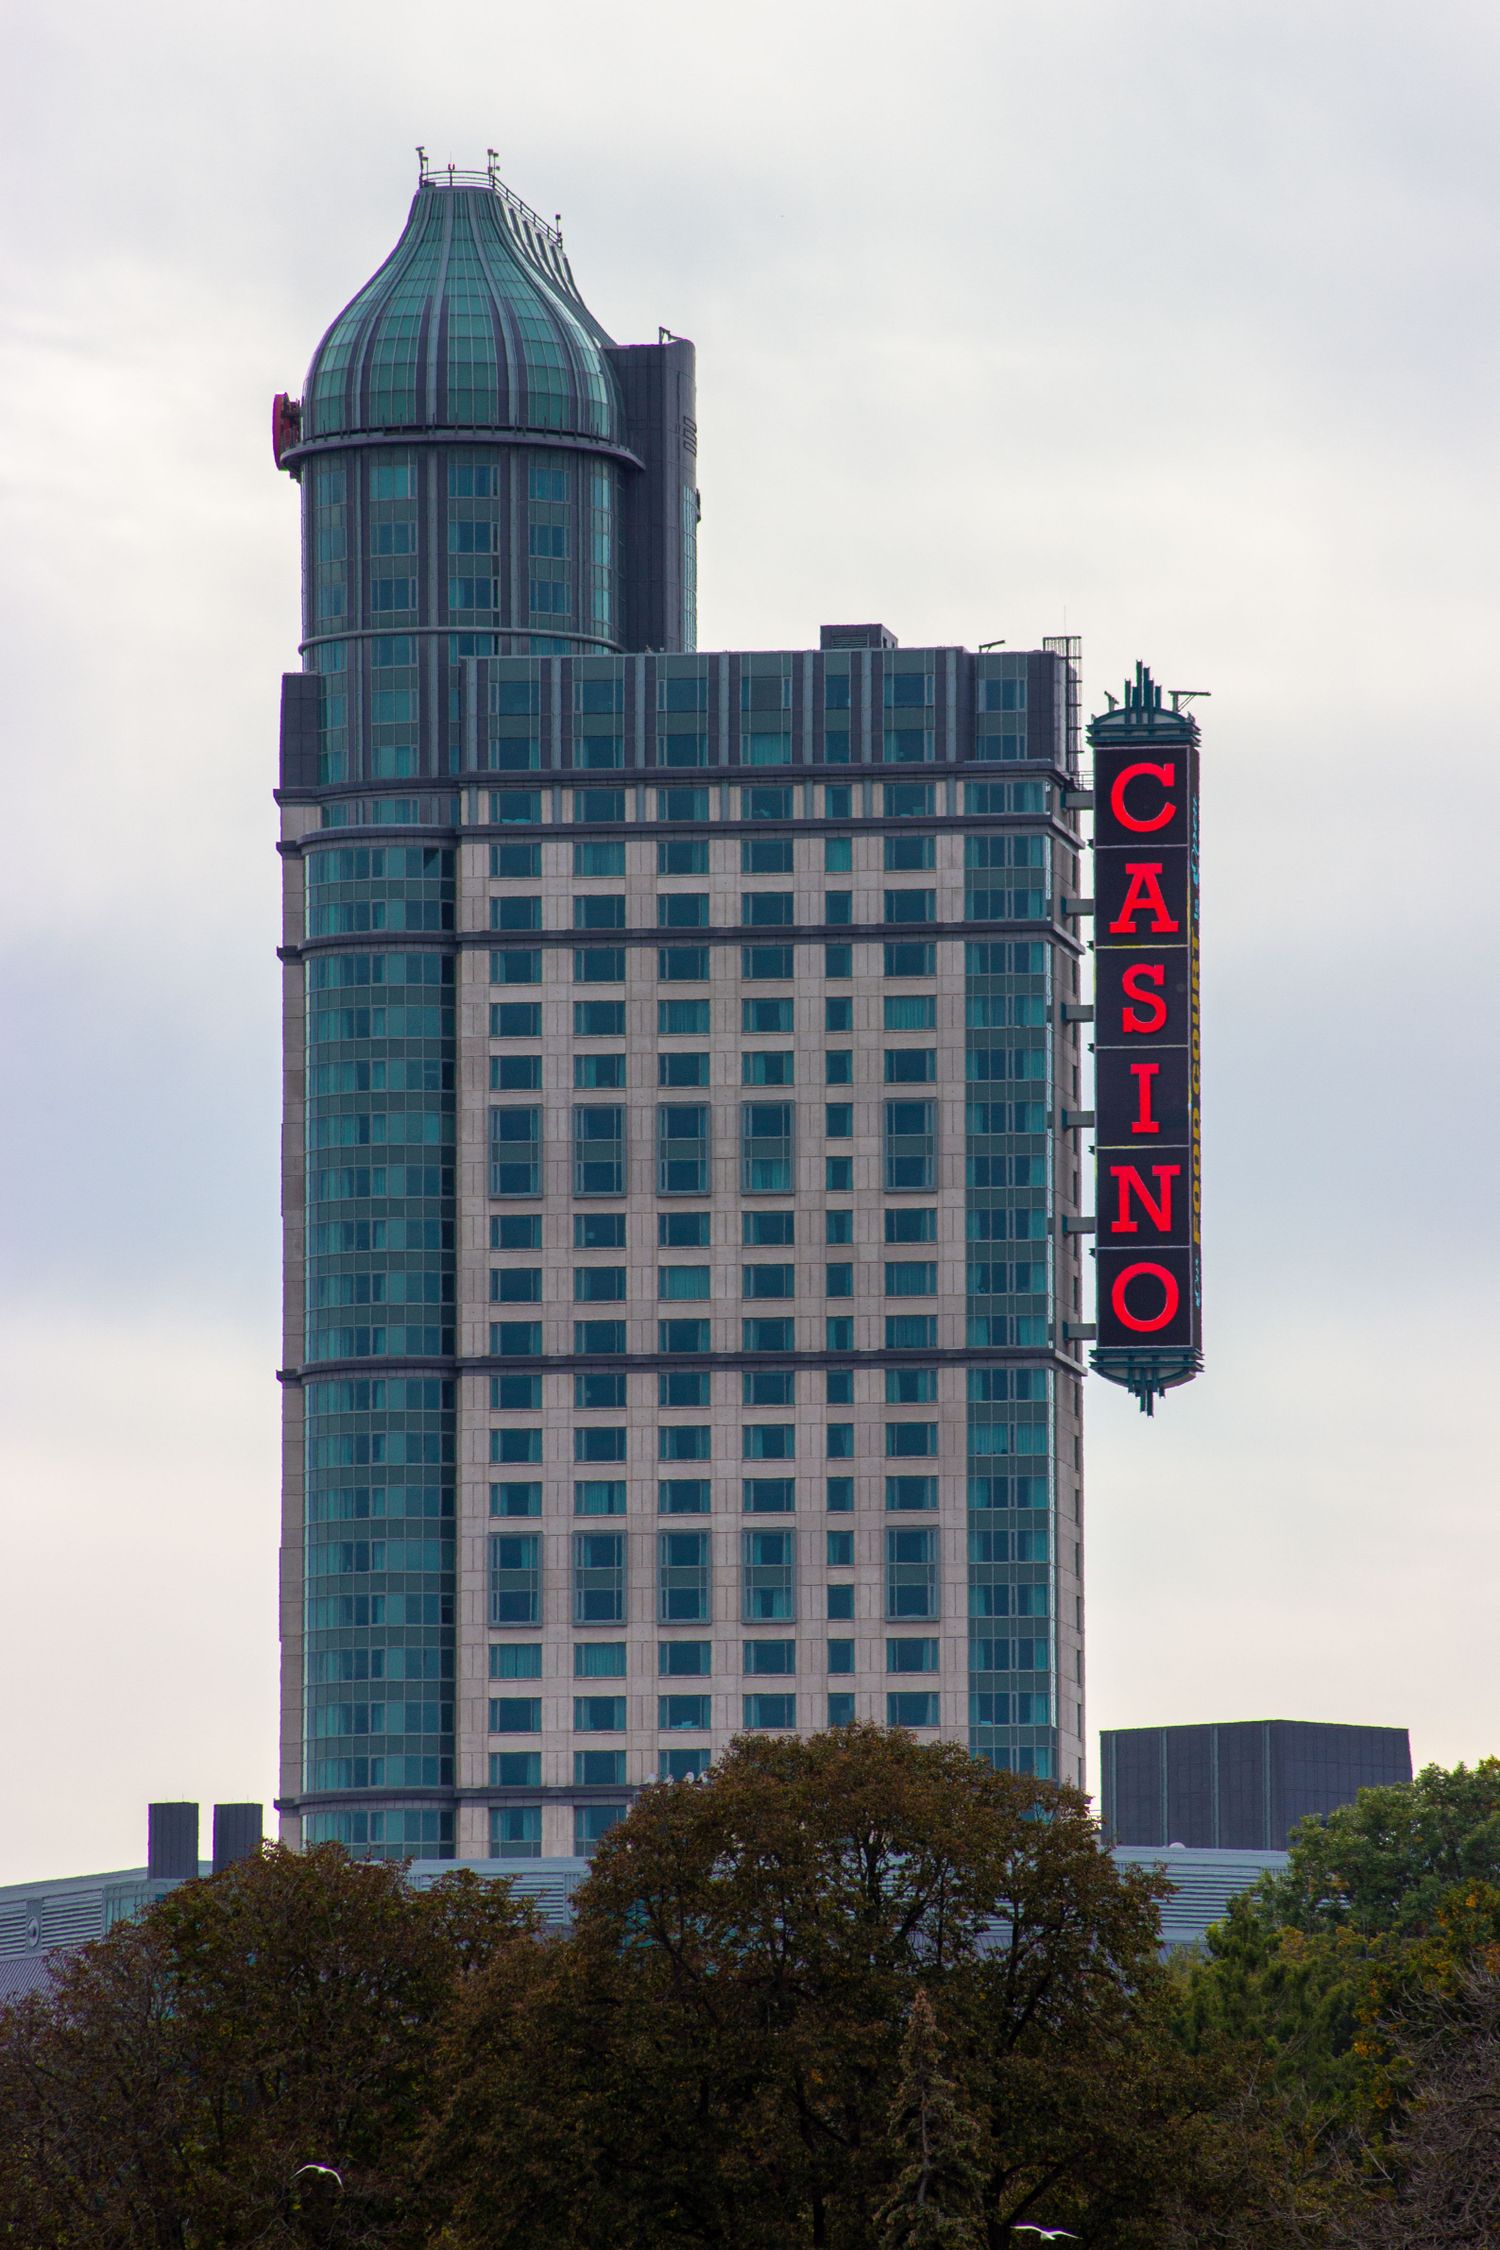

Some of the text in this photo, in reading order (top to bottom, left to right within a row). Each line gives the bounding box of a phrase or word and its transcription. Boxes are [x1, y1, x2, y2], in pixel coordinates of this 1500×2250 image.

[1109, 762, 1180, 1333] CASINO
[1191, 926, 1200, 1095] COURT
[1192, 1107, 1201, 1245] FOOD
